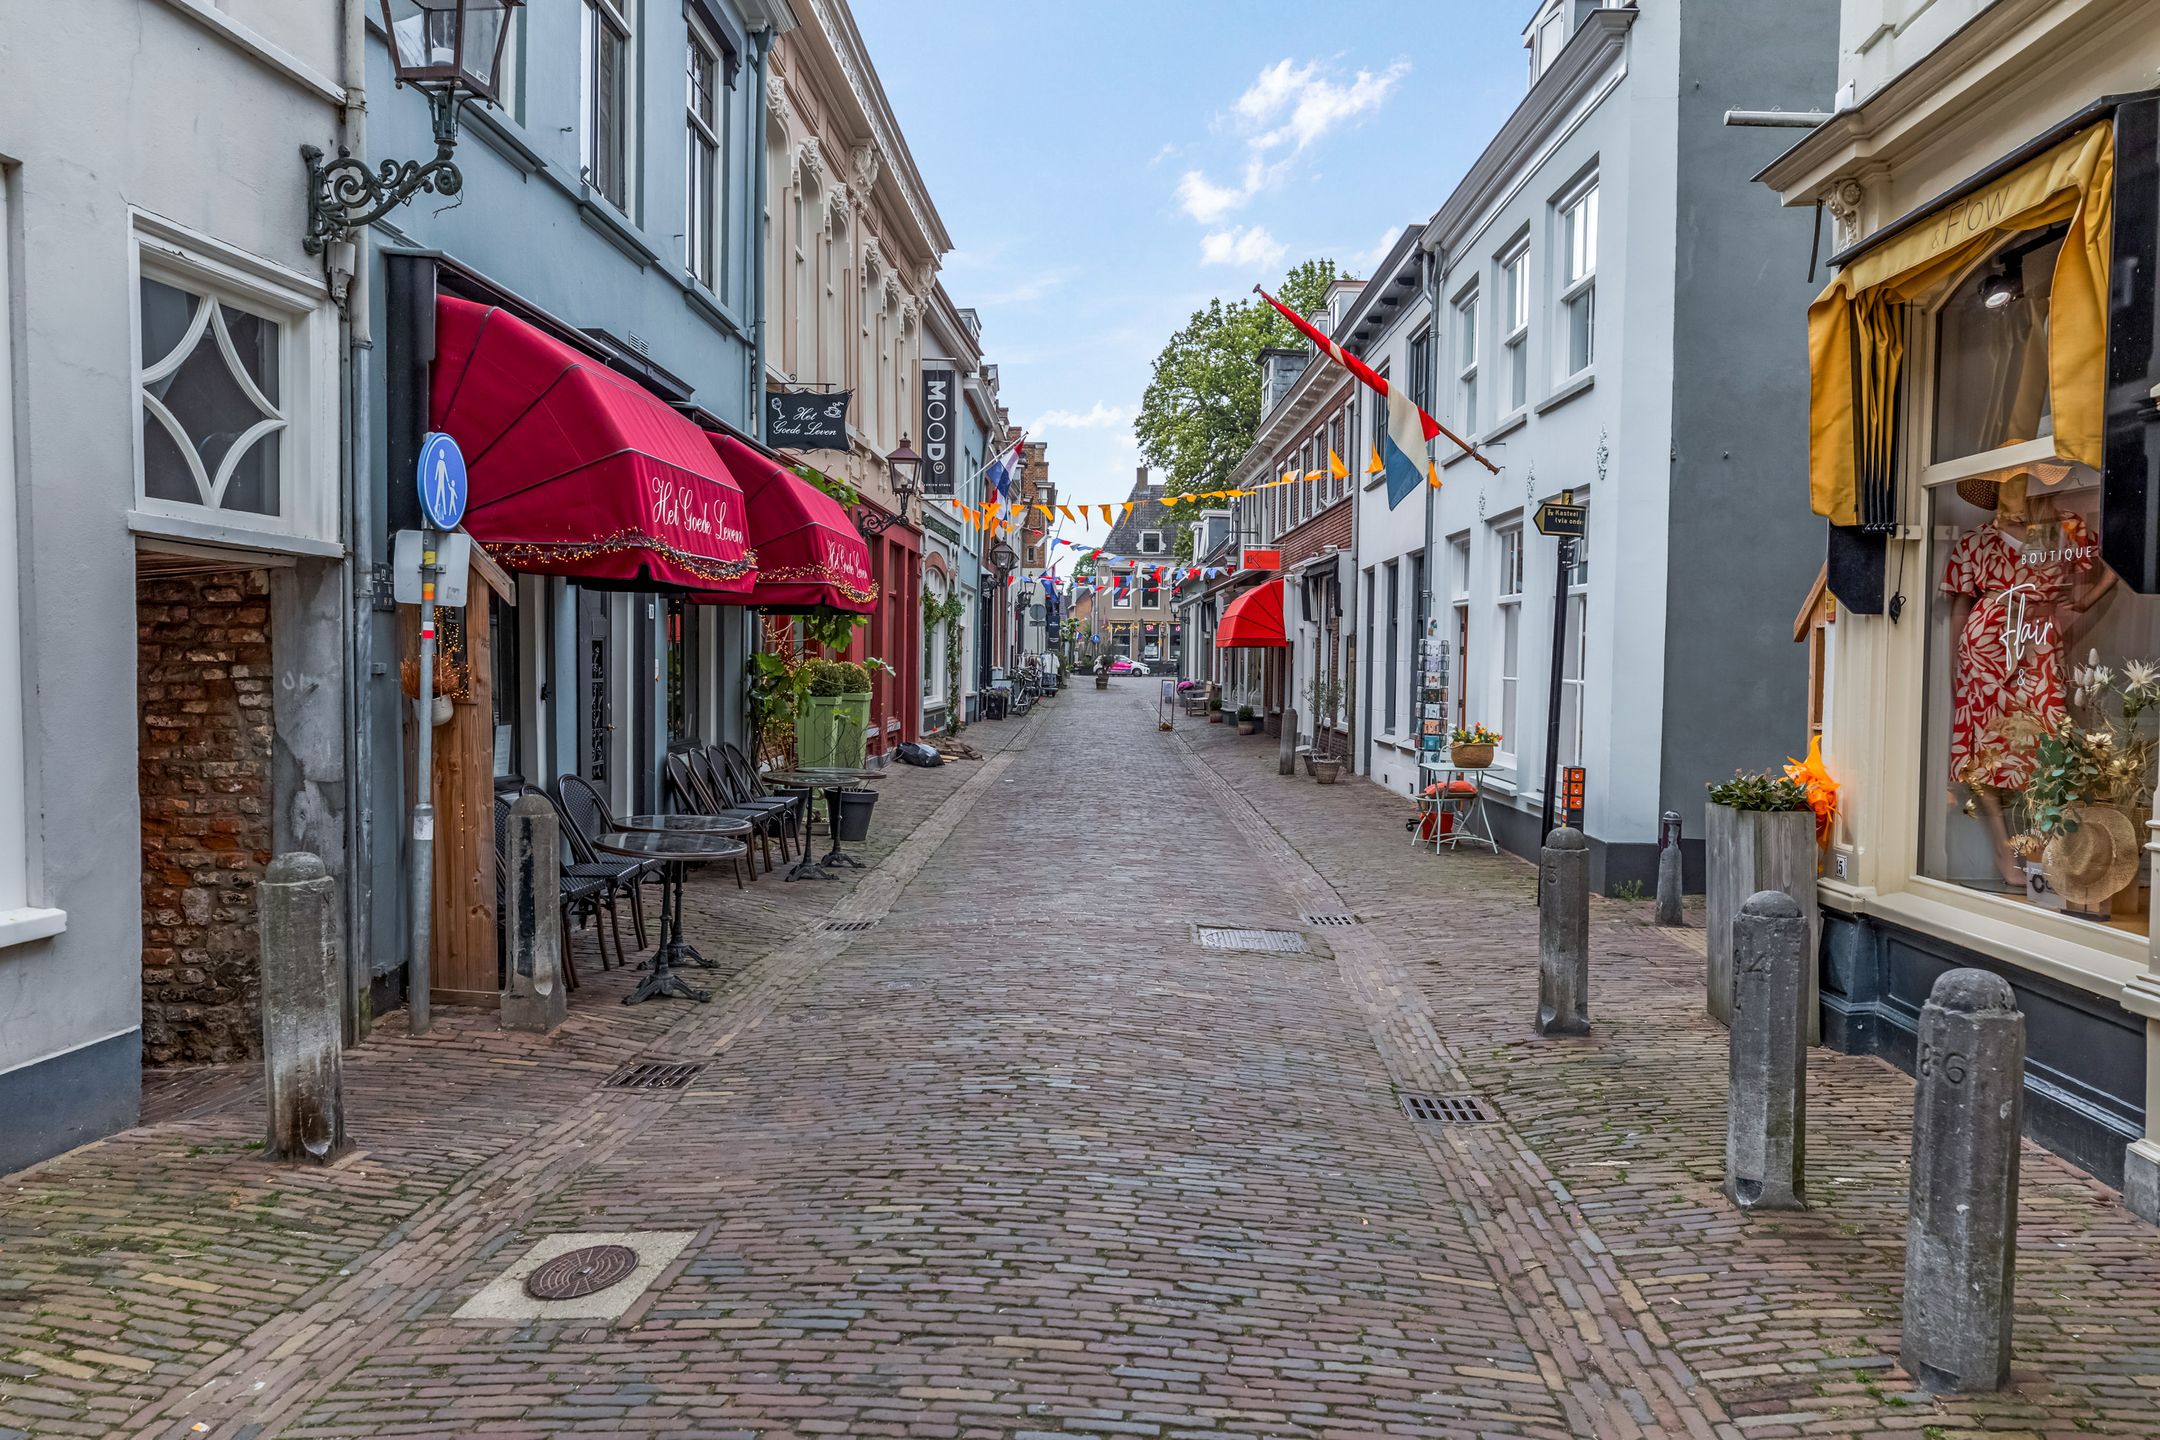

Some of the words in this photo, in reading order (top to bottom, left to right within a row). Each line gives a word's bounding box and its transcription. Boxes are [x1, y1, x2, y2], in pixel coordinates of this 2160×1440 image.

[1943, 186, 2010, 245] Flow
[793, 406, 818, 421] Het
[773, 420, 802, 435] Goede
[804, 421, 837, 436] Leven
[652, 476, 680, 526] Het
[678, 486, 712, 536] Goede
[713, 499, 744, 545] Leven
[1555, 509, 1579, 517] Kasteel
[2021, 545, 2093, 565] BOUTIQUE
[1995, 583, 2054, 671] Flair
[2016, 668, 2027, 686] &
[1836, 859, 1844, 875] 15
